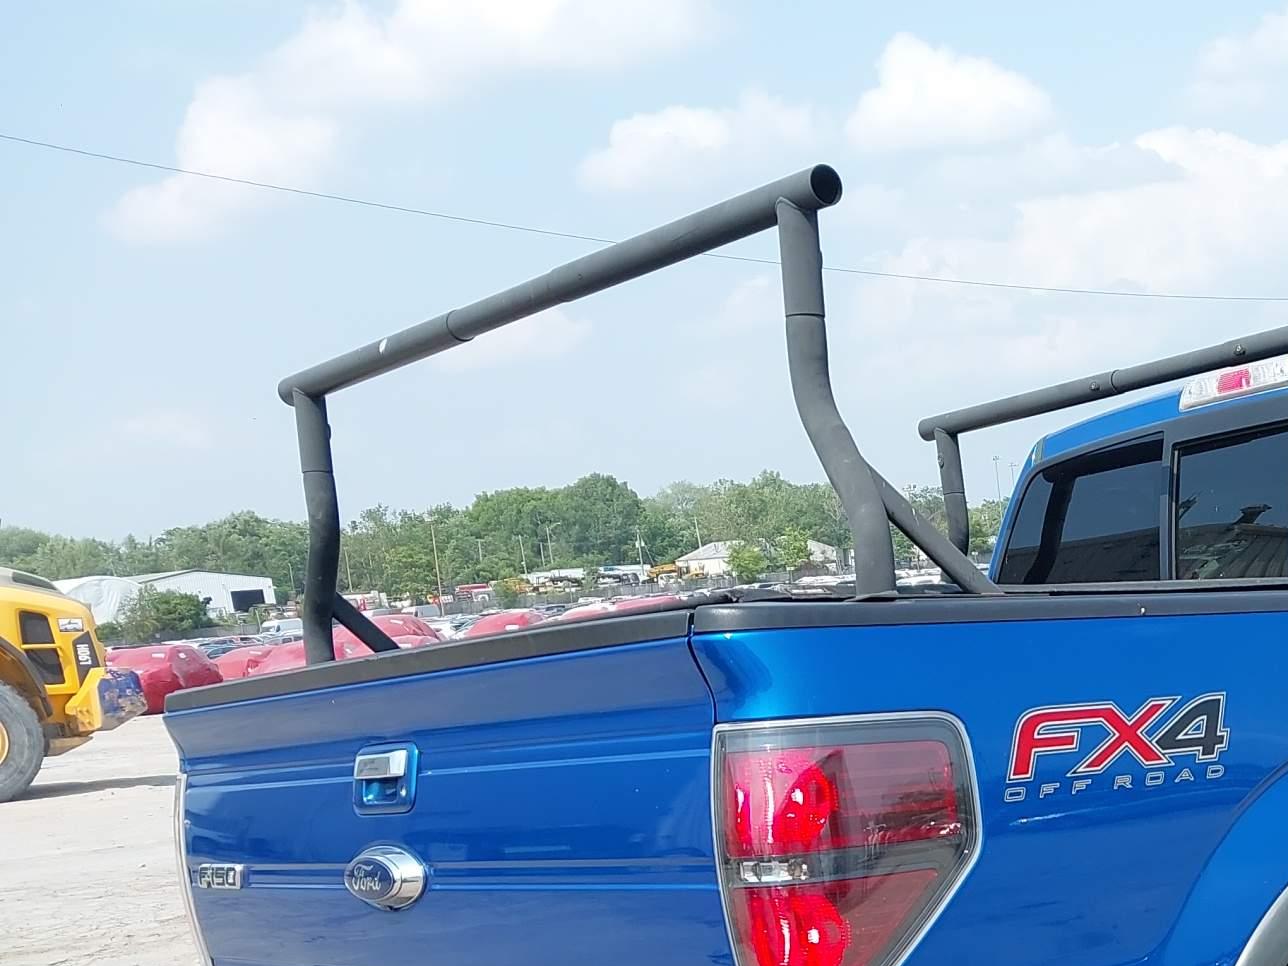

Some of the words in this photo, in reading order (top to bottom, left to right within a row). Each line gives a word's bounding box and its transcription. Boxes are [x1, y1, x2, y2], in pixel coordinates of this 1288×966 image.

[1006, 692, 1230, 784] FX4
[1003, 778, 1093, 803] OFF
[1113, 764, 1225, 791] ROAD
[351, 862, 382, 891] Ford
